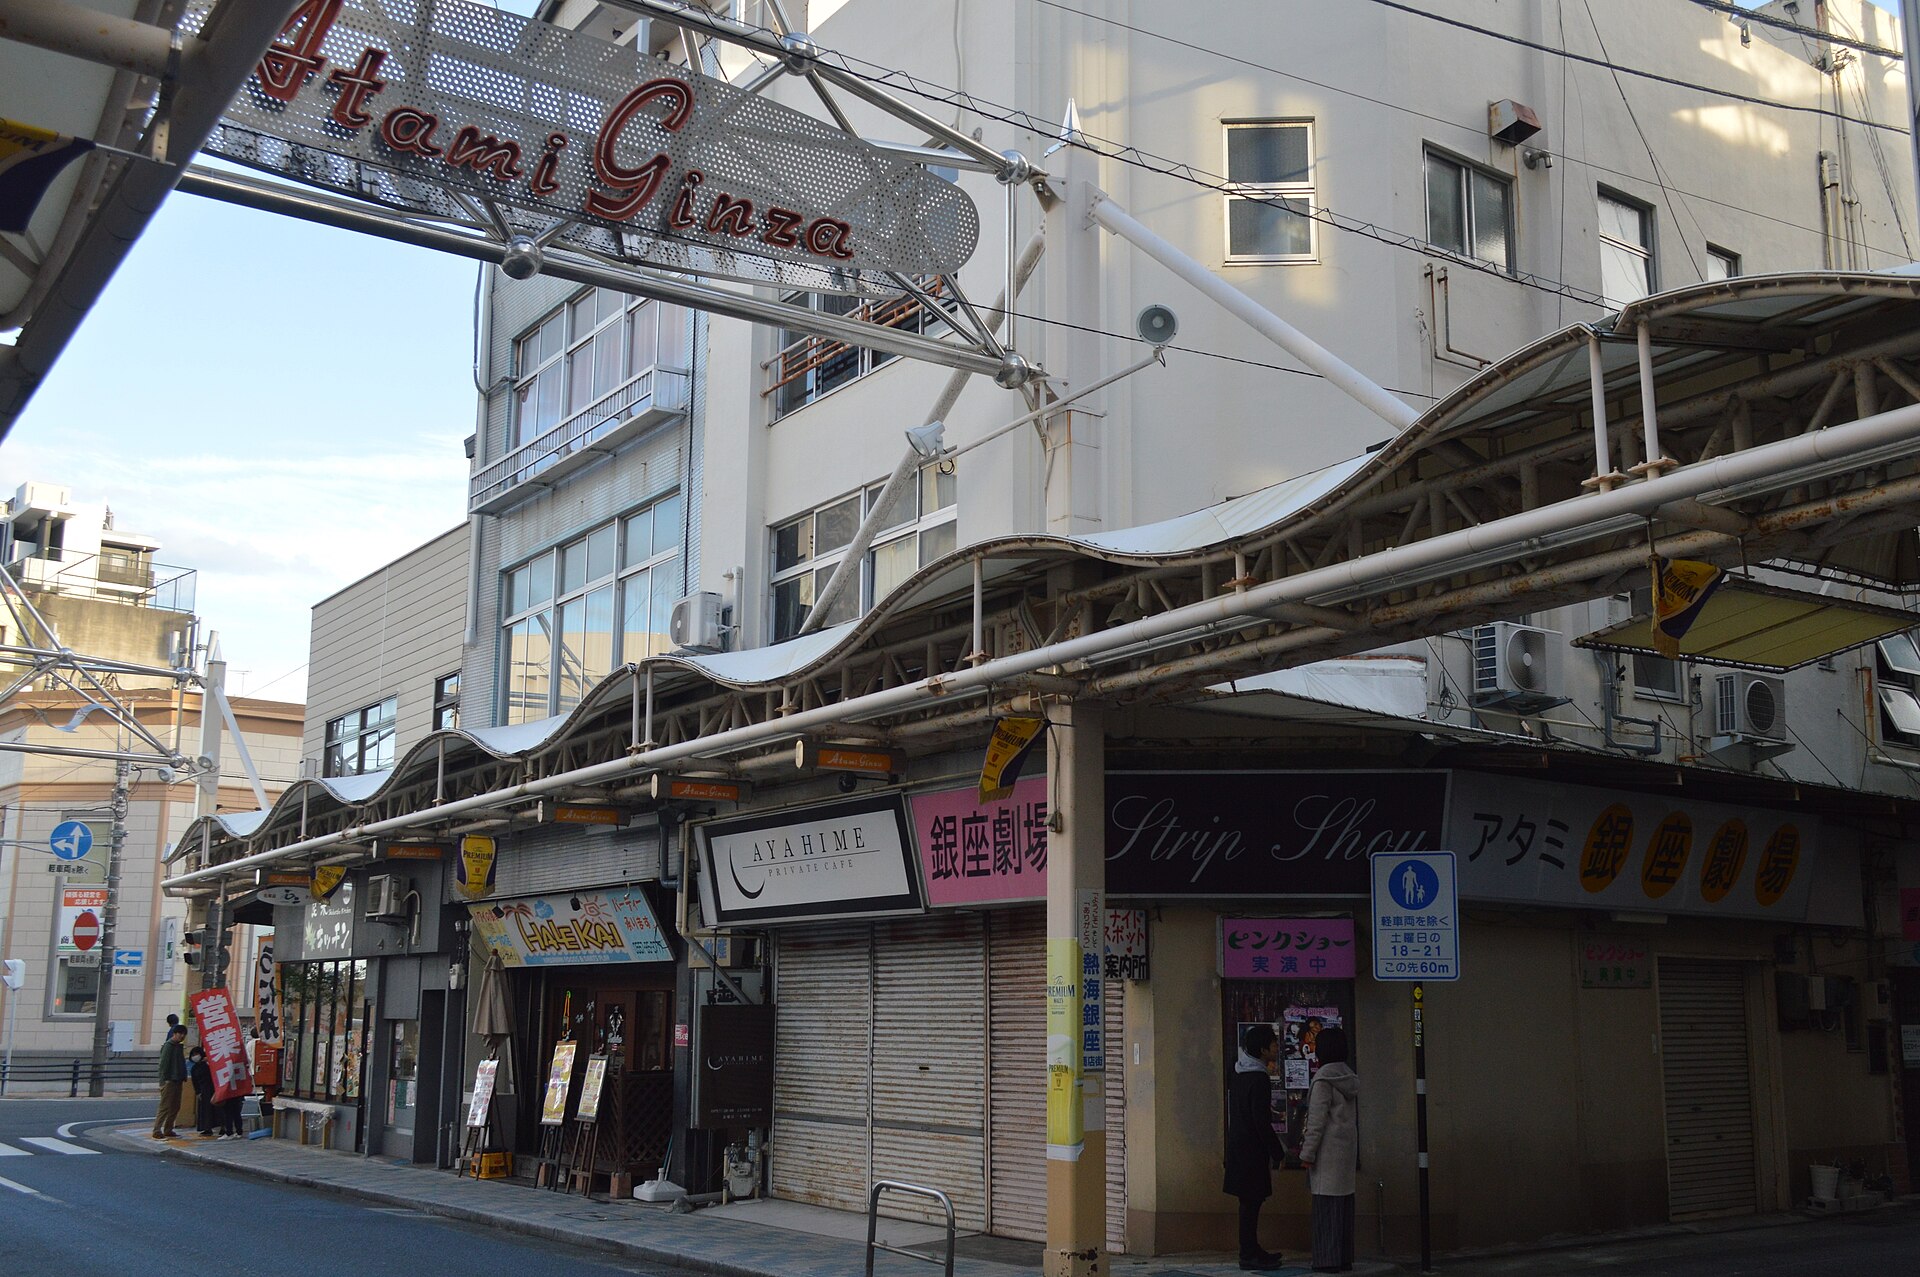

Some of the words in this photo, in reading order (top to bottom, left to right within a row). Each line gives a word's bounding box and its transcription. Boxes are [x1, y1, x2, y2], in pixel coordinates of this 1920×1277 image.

[257, 0, 568, 195] Atami
[584, 78, 854, 260] Ginza
[827, 752, 858, 765] Atami
[680, 784, 708, 795] Atami
[753, 827, 865, 862] AYAHIME
[930, 802, 1047, 880] 銀座劇場
[1104, 795, 1247, 883] Strip
[463, 849, 493, 860] PREMIUM
[1468, 812, 1570, 870] アタミ
[1582, 813, 1797, 894] 銀座劇場
[768, 863, 819, 878] PRIVATE
[824, 859, 854, 871] CAFE
[1109, 909, 1141, 929] ナイト
[1381, 916, 1448, 927] 軽車両を除く
[1228, 930, 1351, 950] ピンクショー
[1391, 932, 1440, 943] 土曜日の
[1105, 954, 1146, 979] 案内所
[1252, 956, 1326, 974] 実演中
[1385, 962, 1449, 973] この先60m
[1083, 952, 1100, 1051] 熱海銀座
[197, 994, 247, 1091] 営業中
